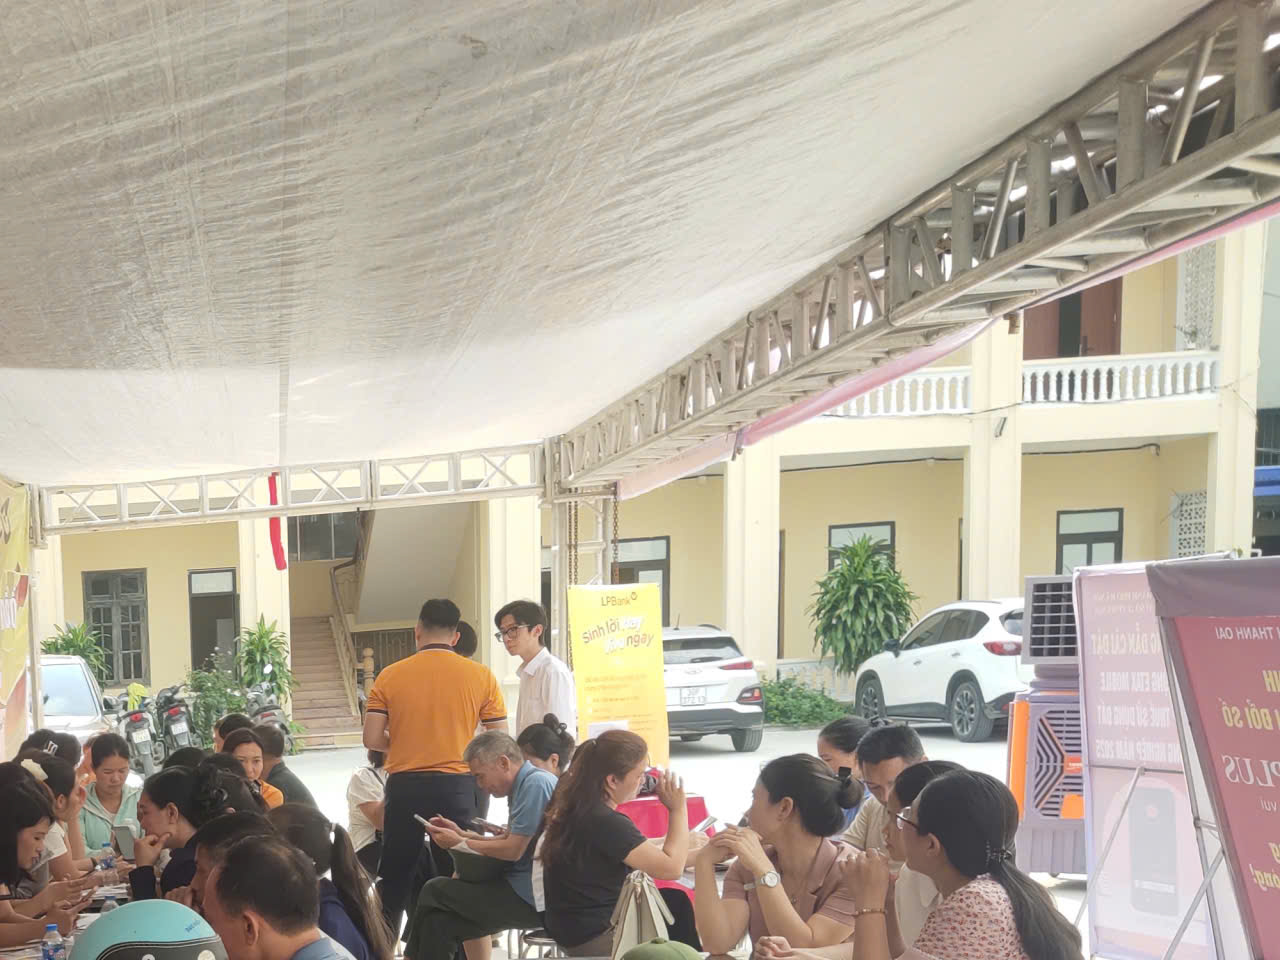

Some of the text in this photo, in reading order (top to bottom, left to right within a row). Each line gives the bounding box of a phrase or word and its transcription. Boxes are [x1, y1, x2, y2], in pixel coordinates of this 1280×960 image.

[600, 595, 631, 607] LPBank
[582, 625, 606, 645] Sinh
[626, 633, 655, 648] ngay
